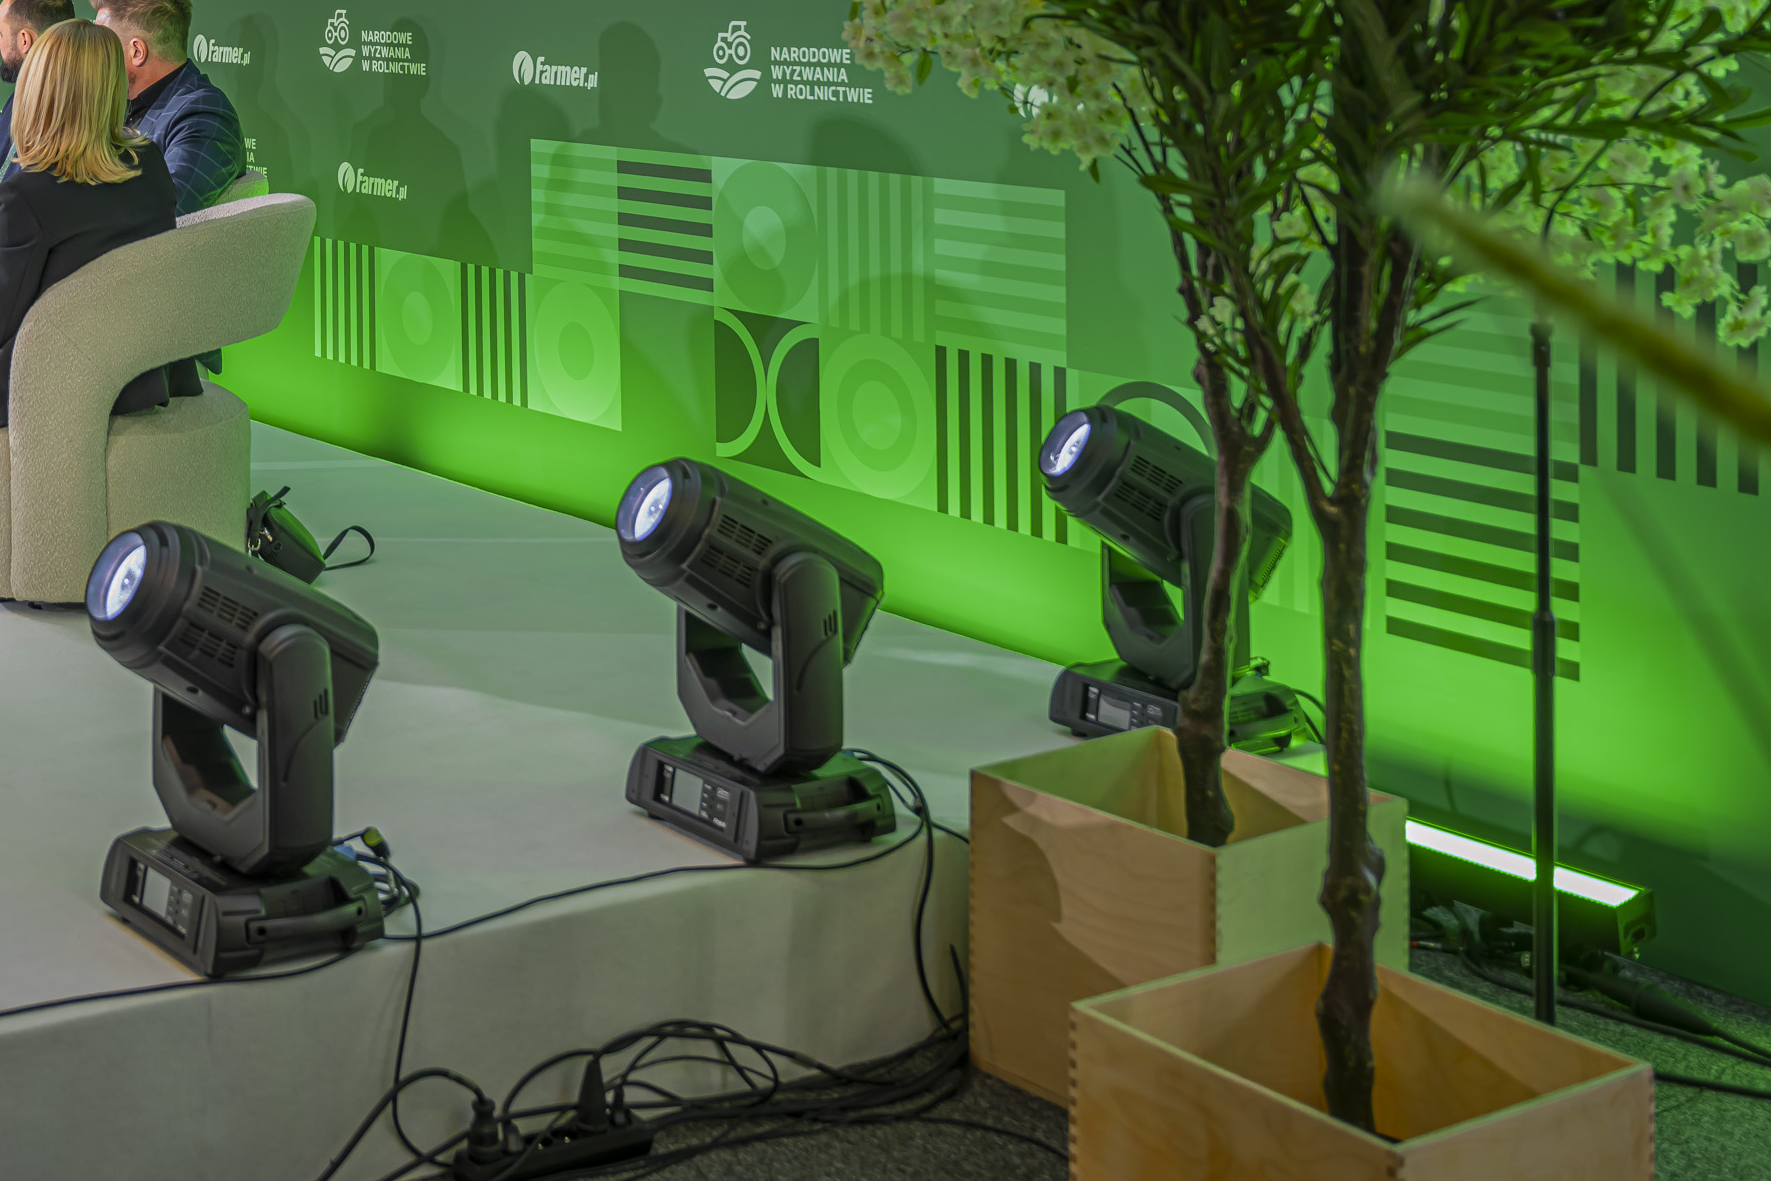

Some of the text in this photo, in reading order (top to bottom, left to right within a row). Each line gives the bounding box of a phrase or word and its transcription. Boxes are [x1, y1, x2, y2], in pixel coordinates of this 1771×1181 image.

[361, 30, 413, 45] NARODOWE
[208, 38, 250, 66] Farmer.pl
[361, 45, 412, 60] WYZWANIA
[770, 46, 851, 65] NARODOWE
[361, 60, 426, 76] W ROLNICTWIE
[535, 56, 598, 90] Farmer.pl
[771, 66, 849, 84] WYZWANIA
[771, 84, 873, 104] W ROLNICTWIE
[356, 168, 408, 201] Farmer.pl
